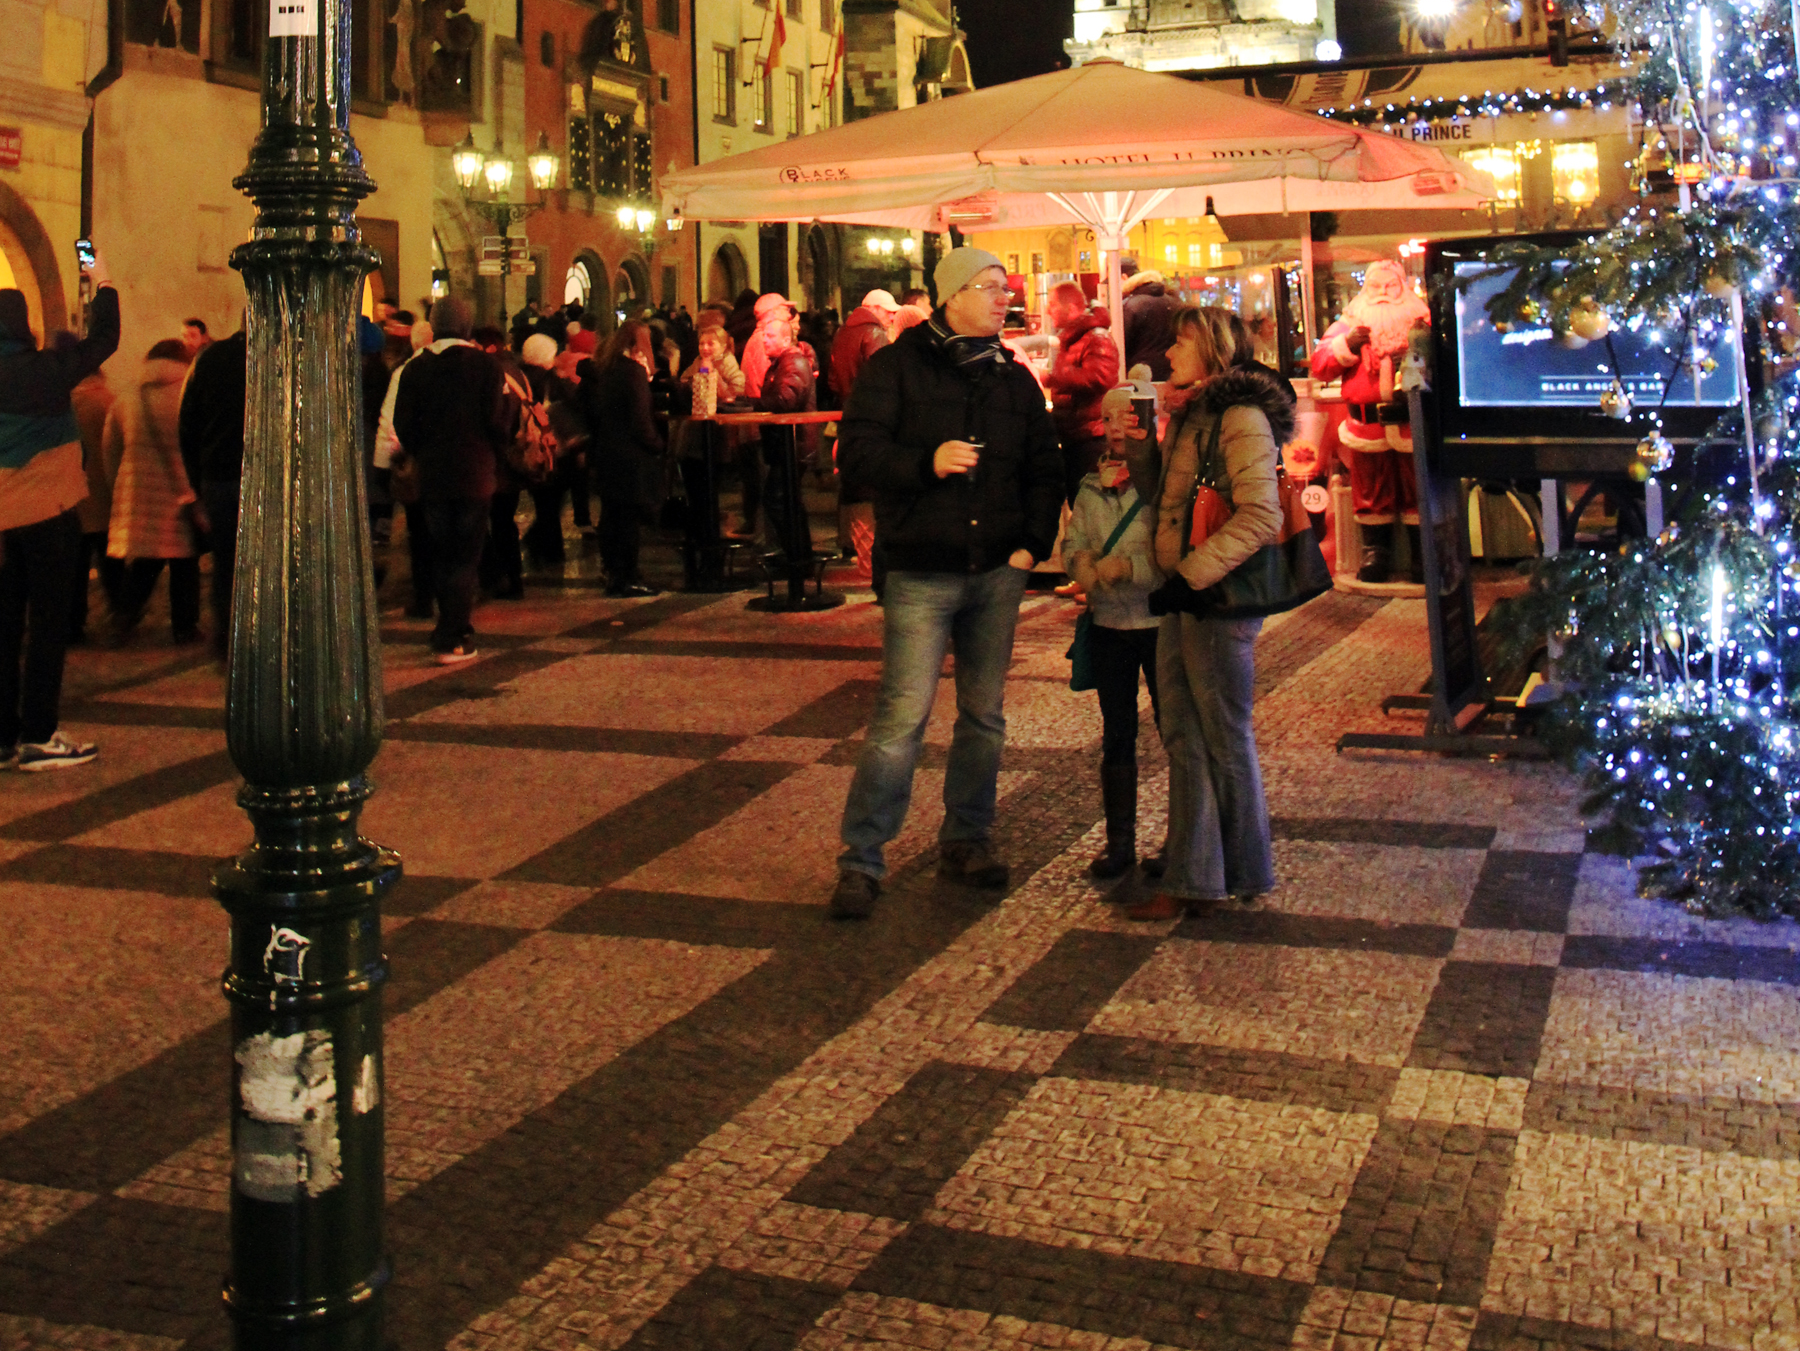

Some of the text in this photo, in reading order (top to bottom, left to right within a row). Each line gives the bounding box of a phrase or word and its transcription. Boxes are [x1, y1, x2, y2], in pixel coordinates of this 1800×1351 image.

[1411, 124, 1472, 142] PRINCE
[786, 167, 849, 180] BLACK
[1541, 382, 1580, 392] BLACK
